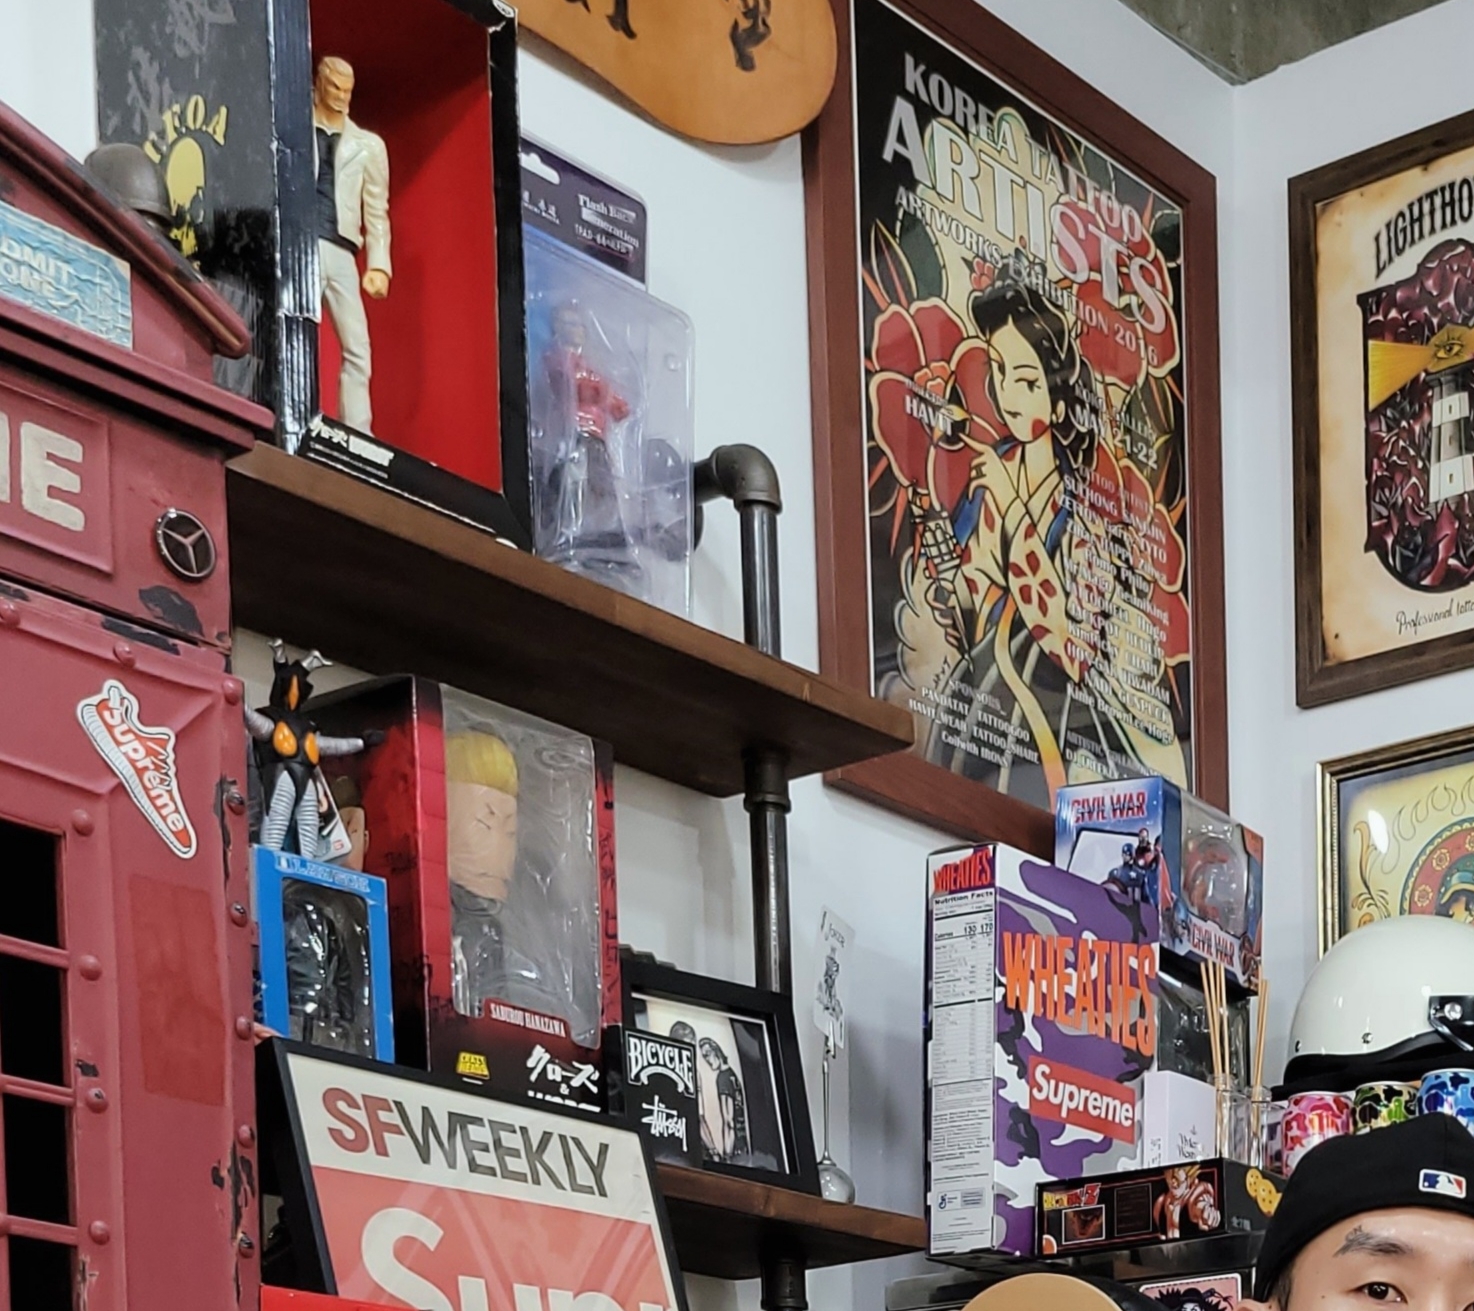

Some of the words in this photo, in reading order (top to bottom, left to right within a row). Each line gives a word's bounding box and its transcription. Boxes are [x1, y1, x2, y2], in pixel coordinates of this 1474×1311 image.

[905, 52, 1018, 163] KOREA
[1026, 135, 1142, 243] TATTOO
[883, 97, 1167, 334] ARTISTS
[896, 186, 1000, 269] ARTWORKS
[1114, 324, 1158, 367] 2016
[906, 395, 954, 436] HAVIT
[0, 412, 86, 532] E
[102, 700, 187, 834] Supreme
[1072, 794, 1110, 824] CIVIL
[1113, 791, 1147, 820] WAR
[933, 847, 991, 894] WHEATIES
[1191, 922, 1212, 957] CIVIL
[1213, 938, 1235, 968] WAR
[1003, 932, 1156, 1057] WHEATIES
[628, 1037, 695, 1093] BICYCLE
[1032, 1066, 1134, 1128] Supreme
